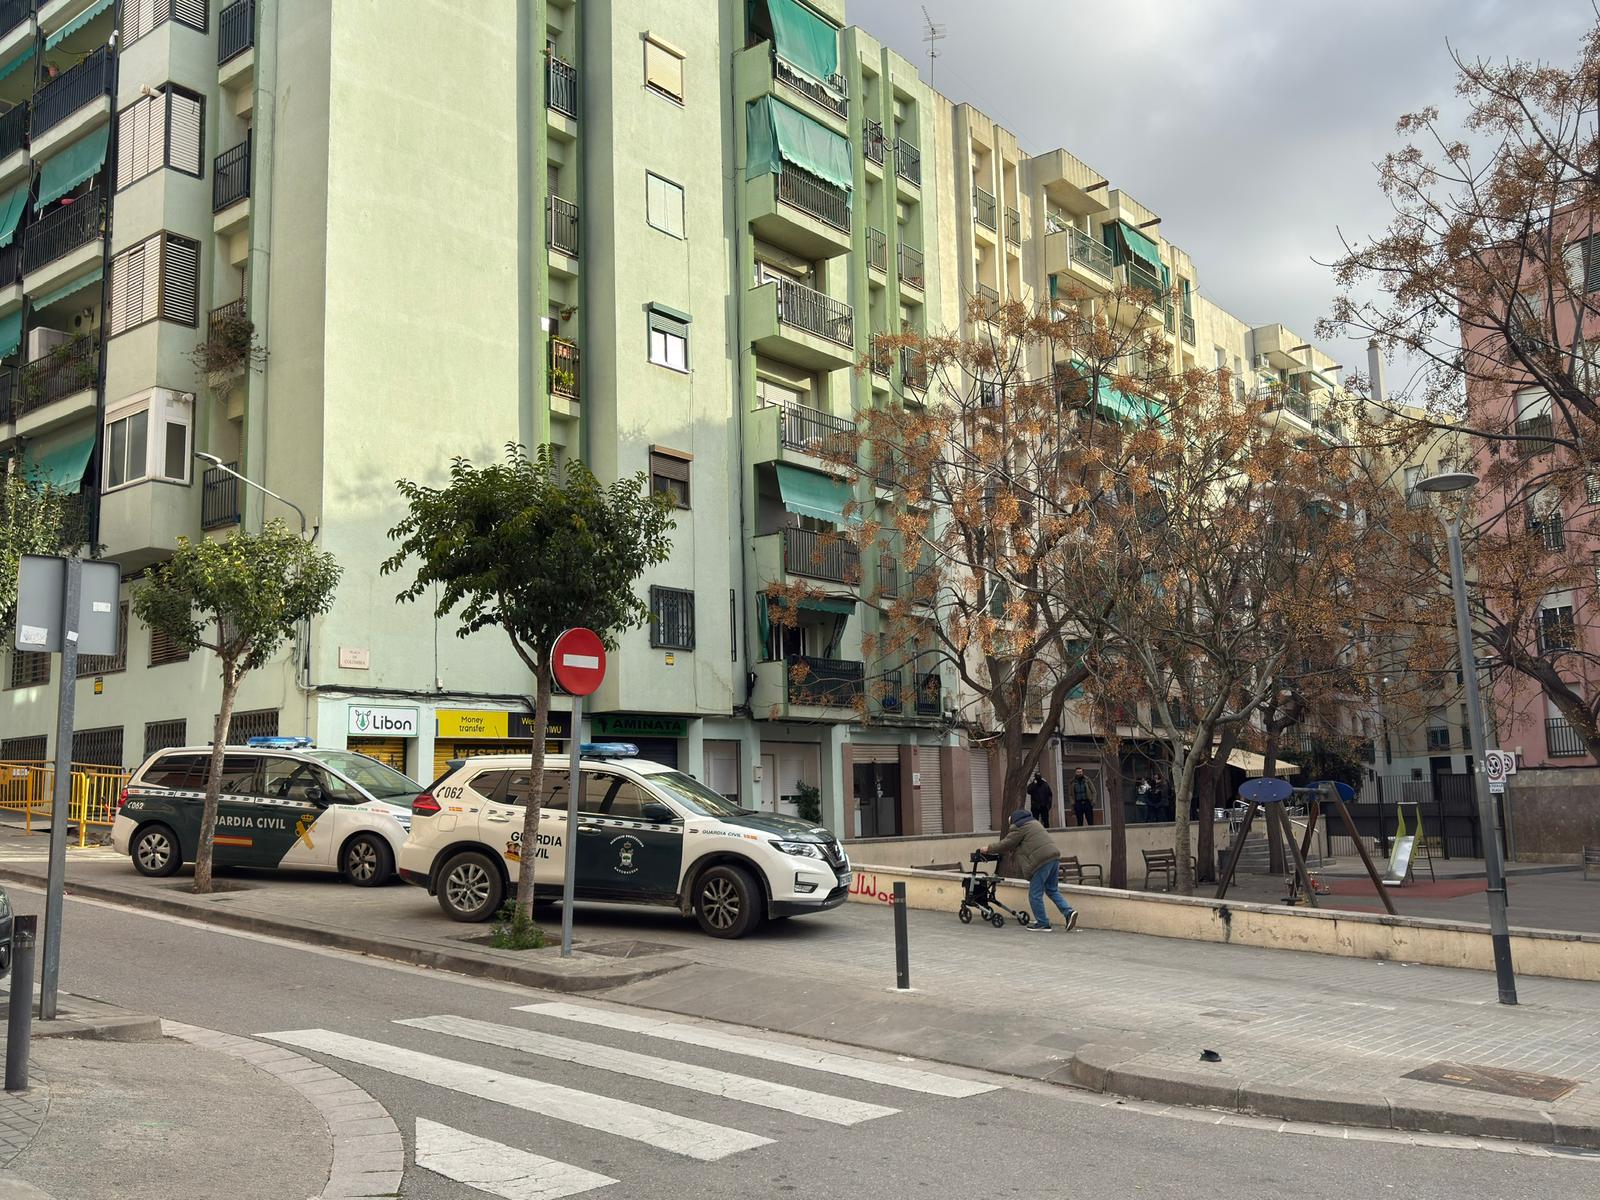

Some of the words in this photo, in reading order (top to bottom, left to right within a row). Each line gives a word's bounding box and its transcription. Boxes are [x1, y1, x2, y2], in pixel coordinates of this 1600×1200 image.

[373, 715, 412, 731] Libon
[461, 716, 484, 724] Money
[613, 719, 681, 730] AMINATA
[459, 724, 485, 732] transfer
[444, 786, 463, 799] 062
[131, 801, 144, 810] 062
[215, 815, 254, 828] UARDIA
[256, 818, 286, 829] CIVIL
[511, 831, 562, 847] GRDIA
